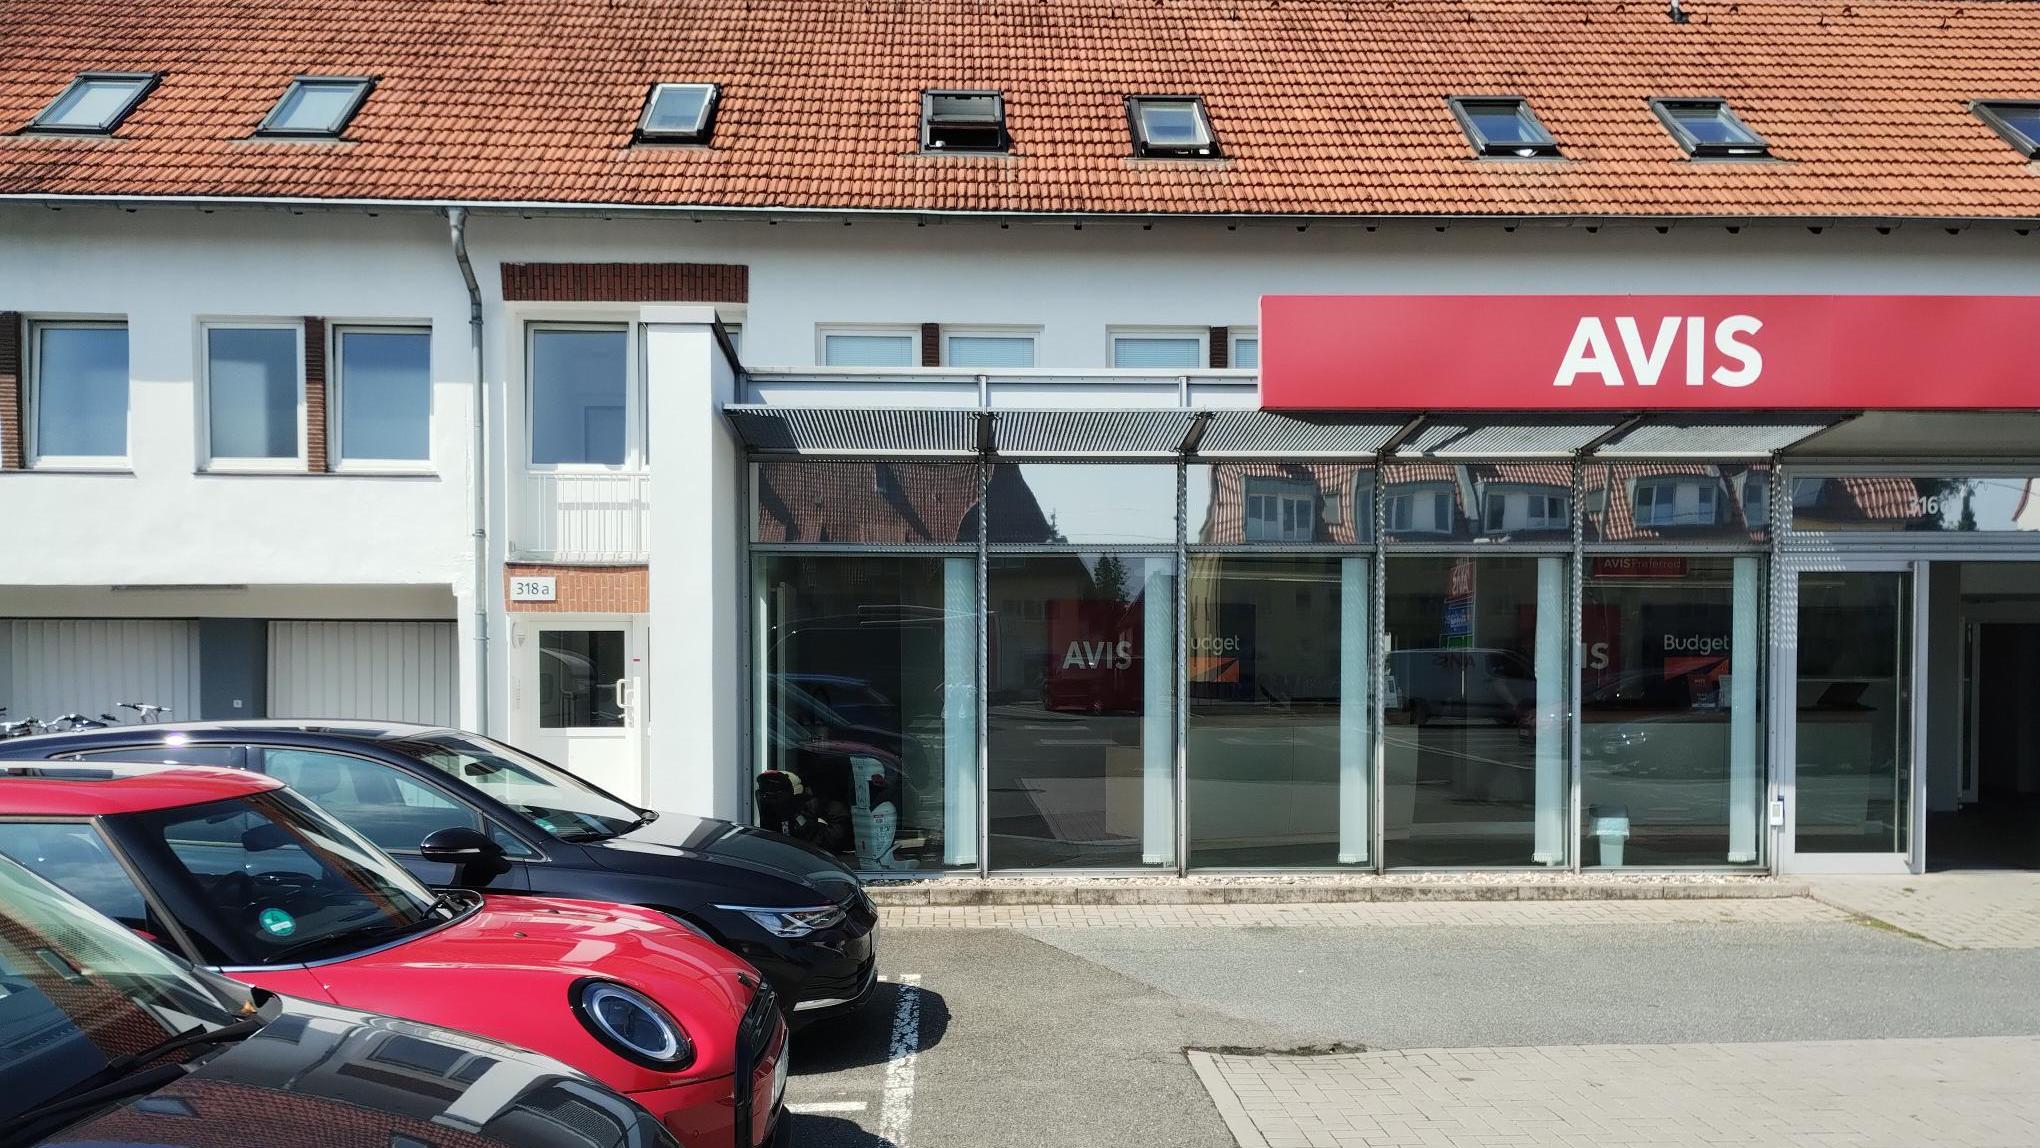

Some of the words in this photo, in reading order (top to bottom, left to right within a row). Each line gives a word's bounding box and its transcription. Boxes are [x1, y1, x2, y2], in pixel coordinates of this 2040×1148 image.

[1553, 314, 1763, 387] AVIS
[1604, 558, 1631, 569] AVIS
[516, 582, 539, 595] 318
[541, 585, 549, 595] a
[1062, 639, 1133, 670] AVIS
[1190, 634, 1240, 655] udget
[1663, 634, 1730, 655] Budget
[1582, 642, 1609, 669] IS
